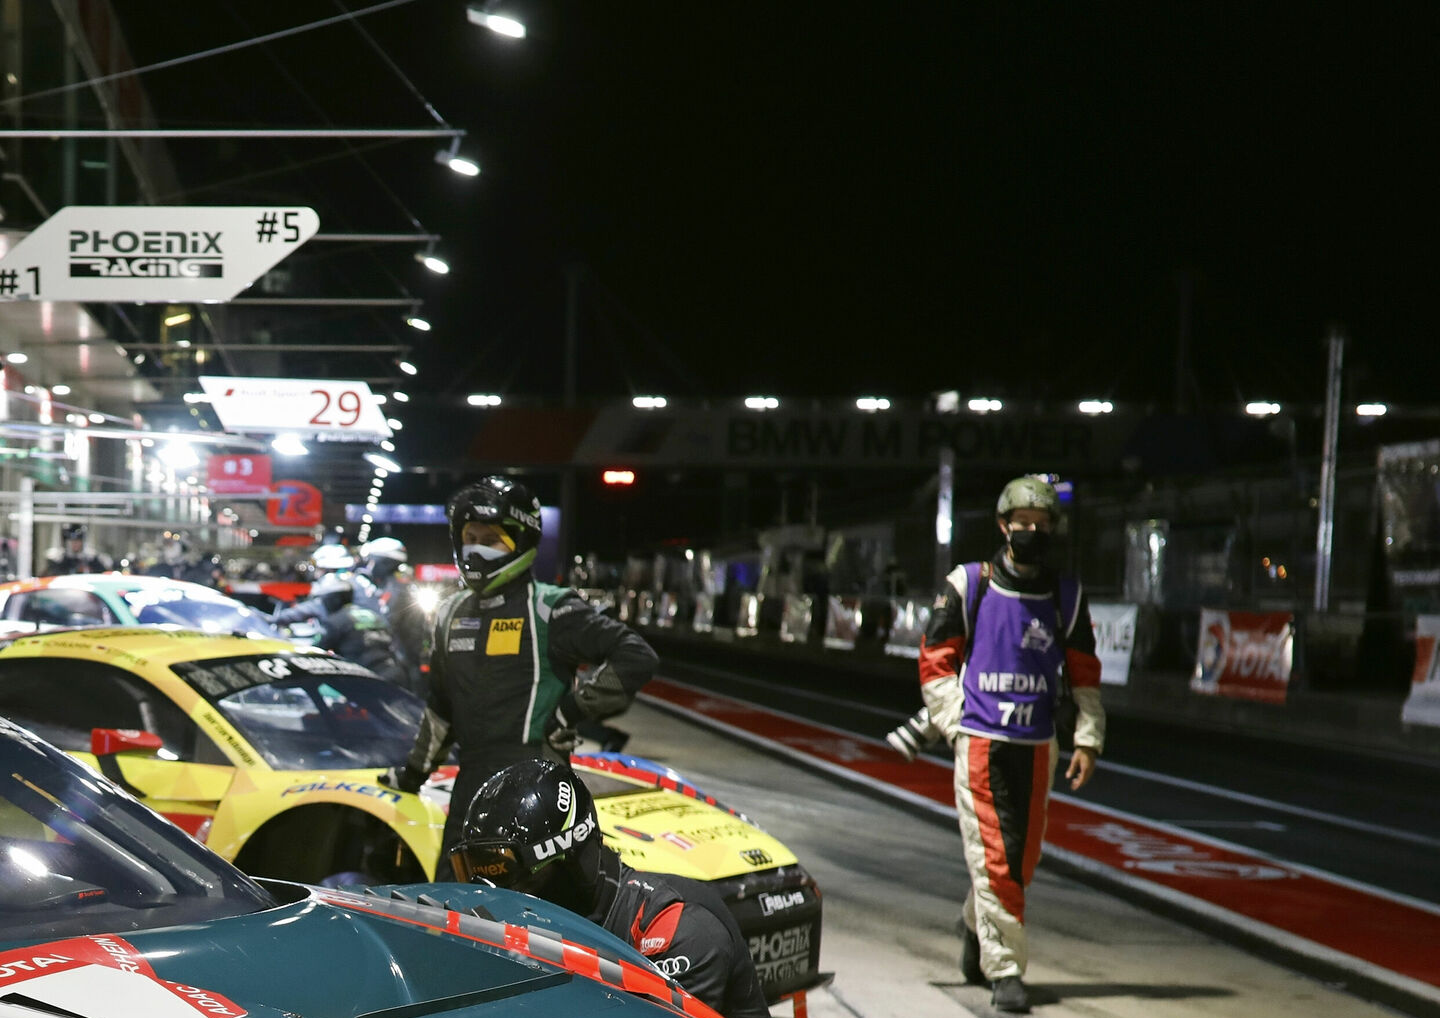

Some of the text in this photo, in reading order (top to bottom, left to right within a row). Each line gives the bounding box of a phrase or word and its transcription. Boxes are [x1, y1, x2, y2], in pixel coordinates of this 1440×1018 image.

[256, 212, 300, 243] #5
[309, 389, 362, 427] 29
[726, 418, 1094, 458] BMW M POWER
[492, 620, 522, 633] ADAC
[978, 671, 1048, 694] MEDIA
[532, 812, 597, 862] uvex
[174, 984, 237, 1017] ADAC
